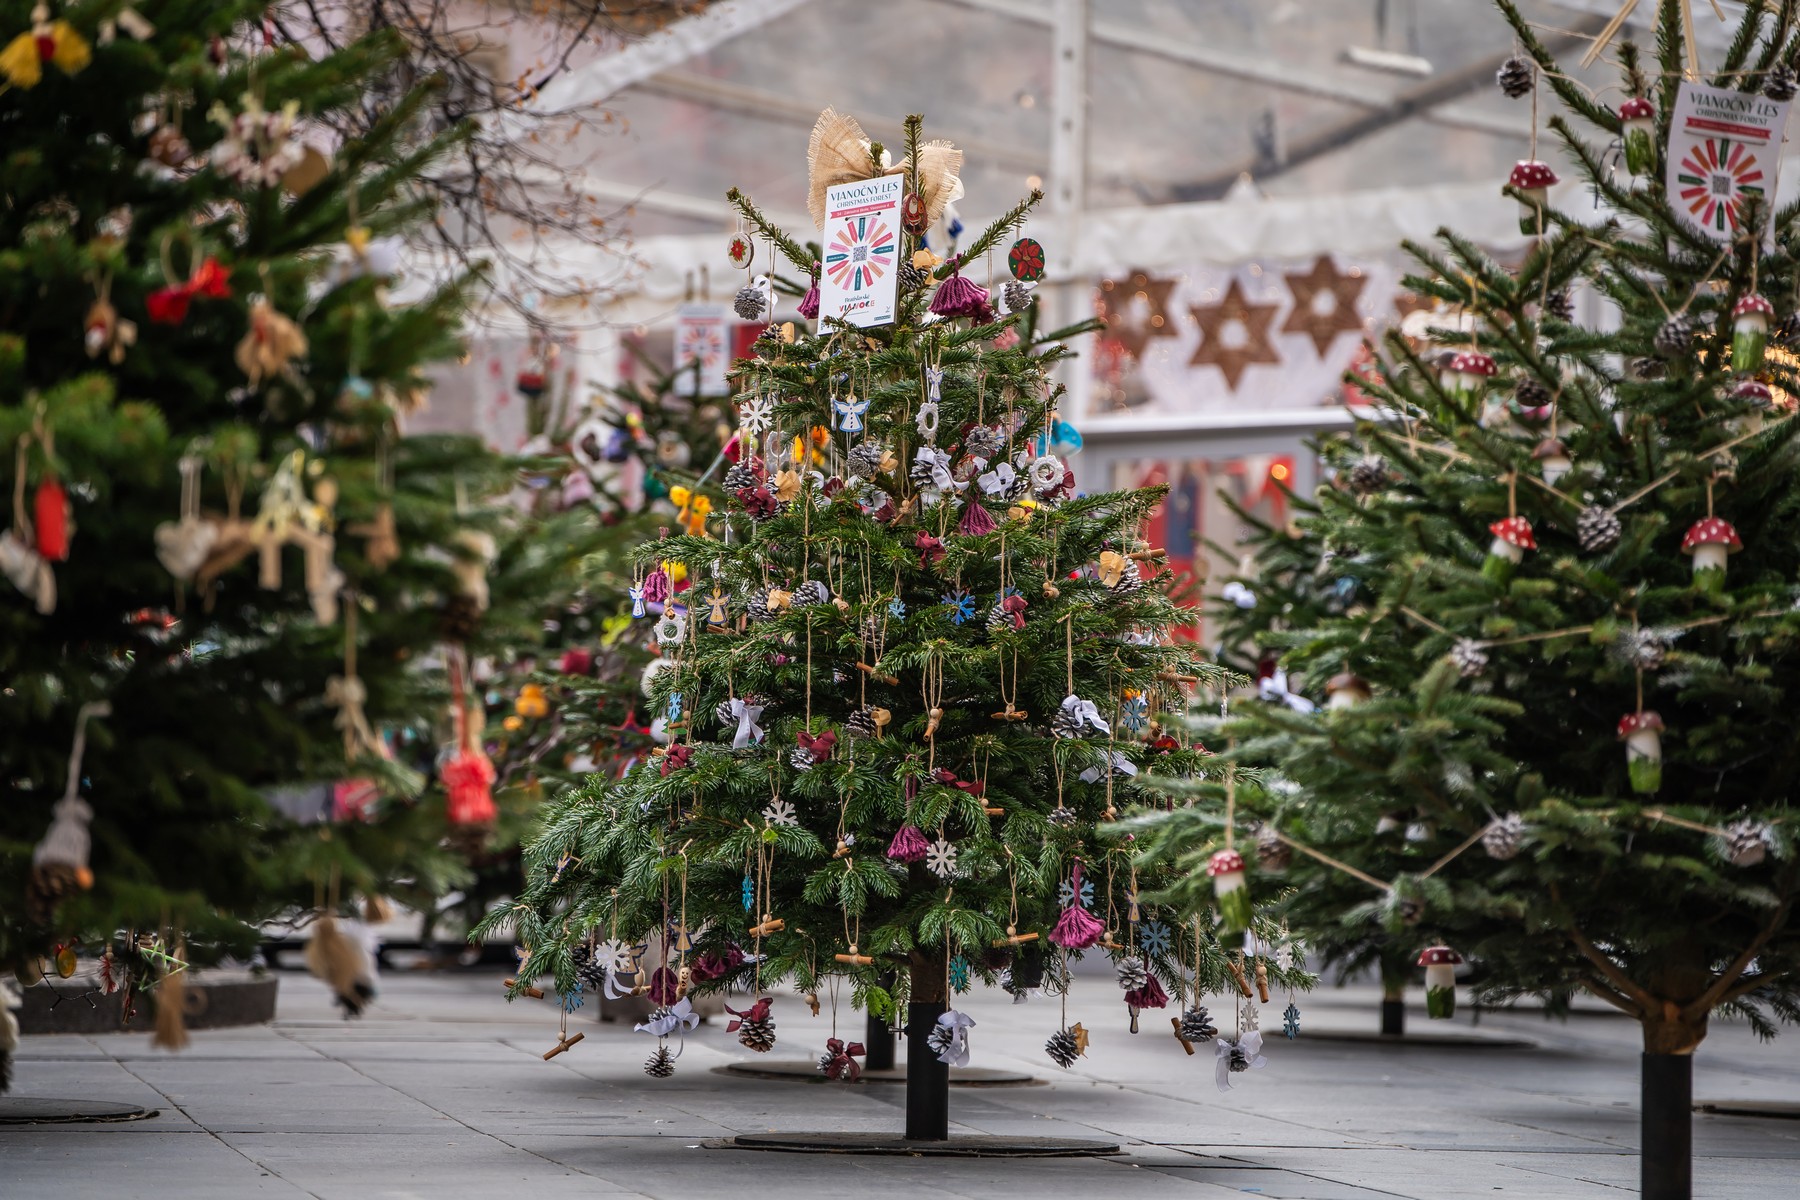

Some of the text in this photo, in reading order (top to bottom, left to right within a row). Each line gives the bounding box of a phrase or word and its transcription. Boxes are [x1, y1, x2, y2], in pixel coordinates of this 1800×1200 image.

[1696, 108, 1768, 126] CHRISTMAS FOREST
[1757, 103, 1779, 117] LES
[831, 181, 899, 202] VIANOČNÝ LES
[836, 193, 892, 209] CHRISTMAS FOREST
